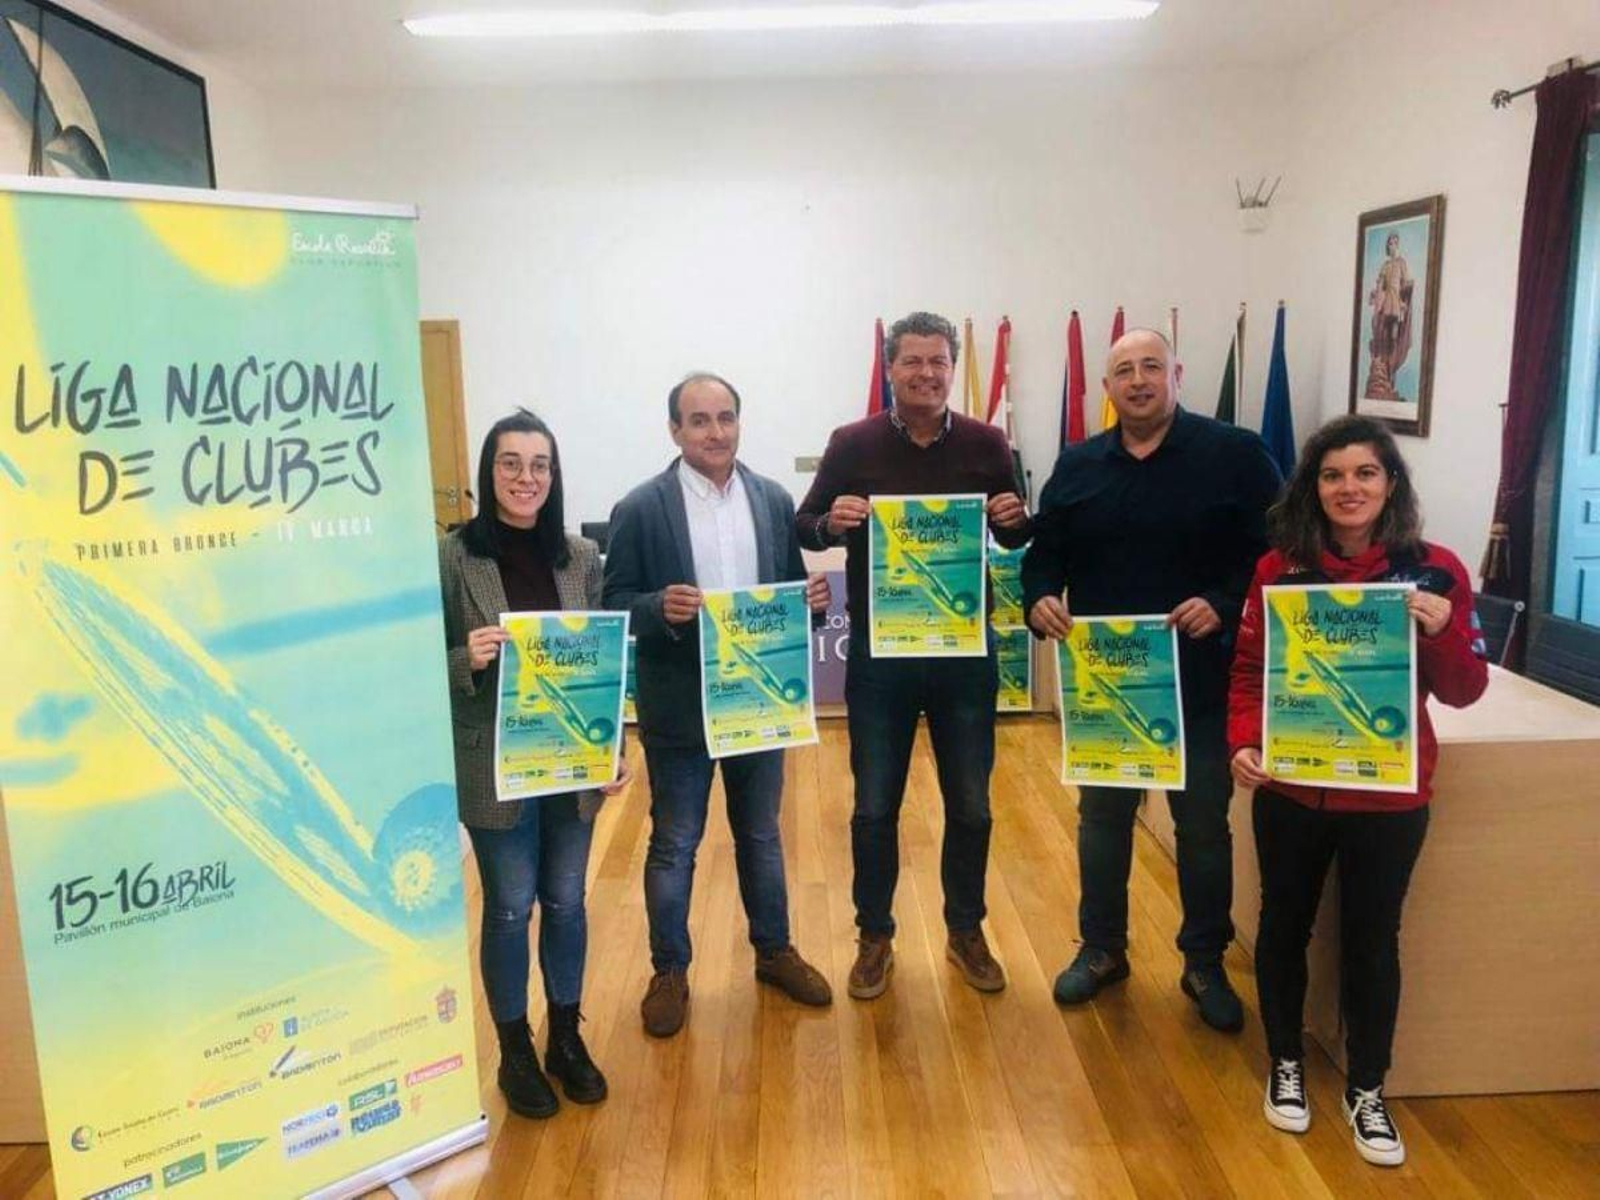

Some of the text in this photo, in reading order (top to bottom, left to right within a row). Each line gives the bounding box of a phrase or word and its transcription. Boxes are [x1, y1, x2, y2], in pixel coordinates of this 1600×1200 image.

[14, 355, 396, 435] LIGA NACIONAL
[78, 429, 383, 516] DE CLUBES
[76, 538, 160, 561] PRIMERA
[49, 861, 236, 930] 15-16 ABRIL
[109, 905, 171, 932] municipal
[203, 1035, 251, 1060] BAIONA
